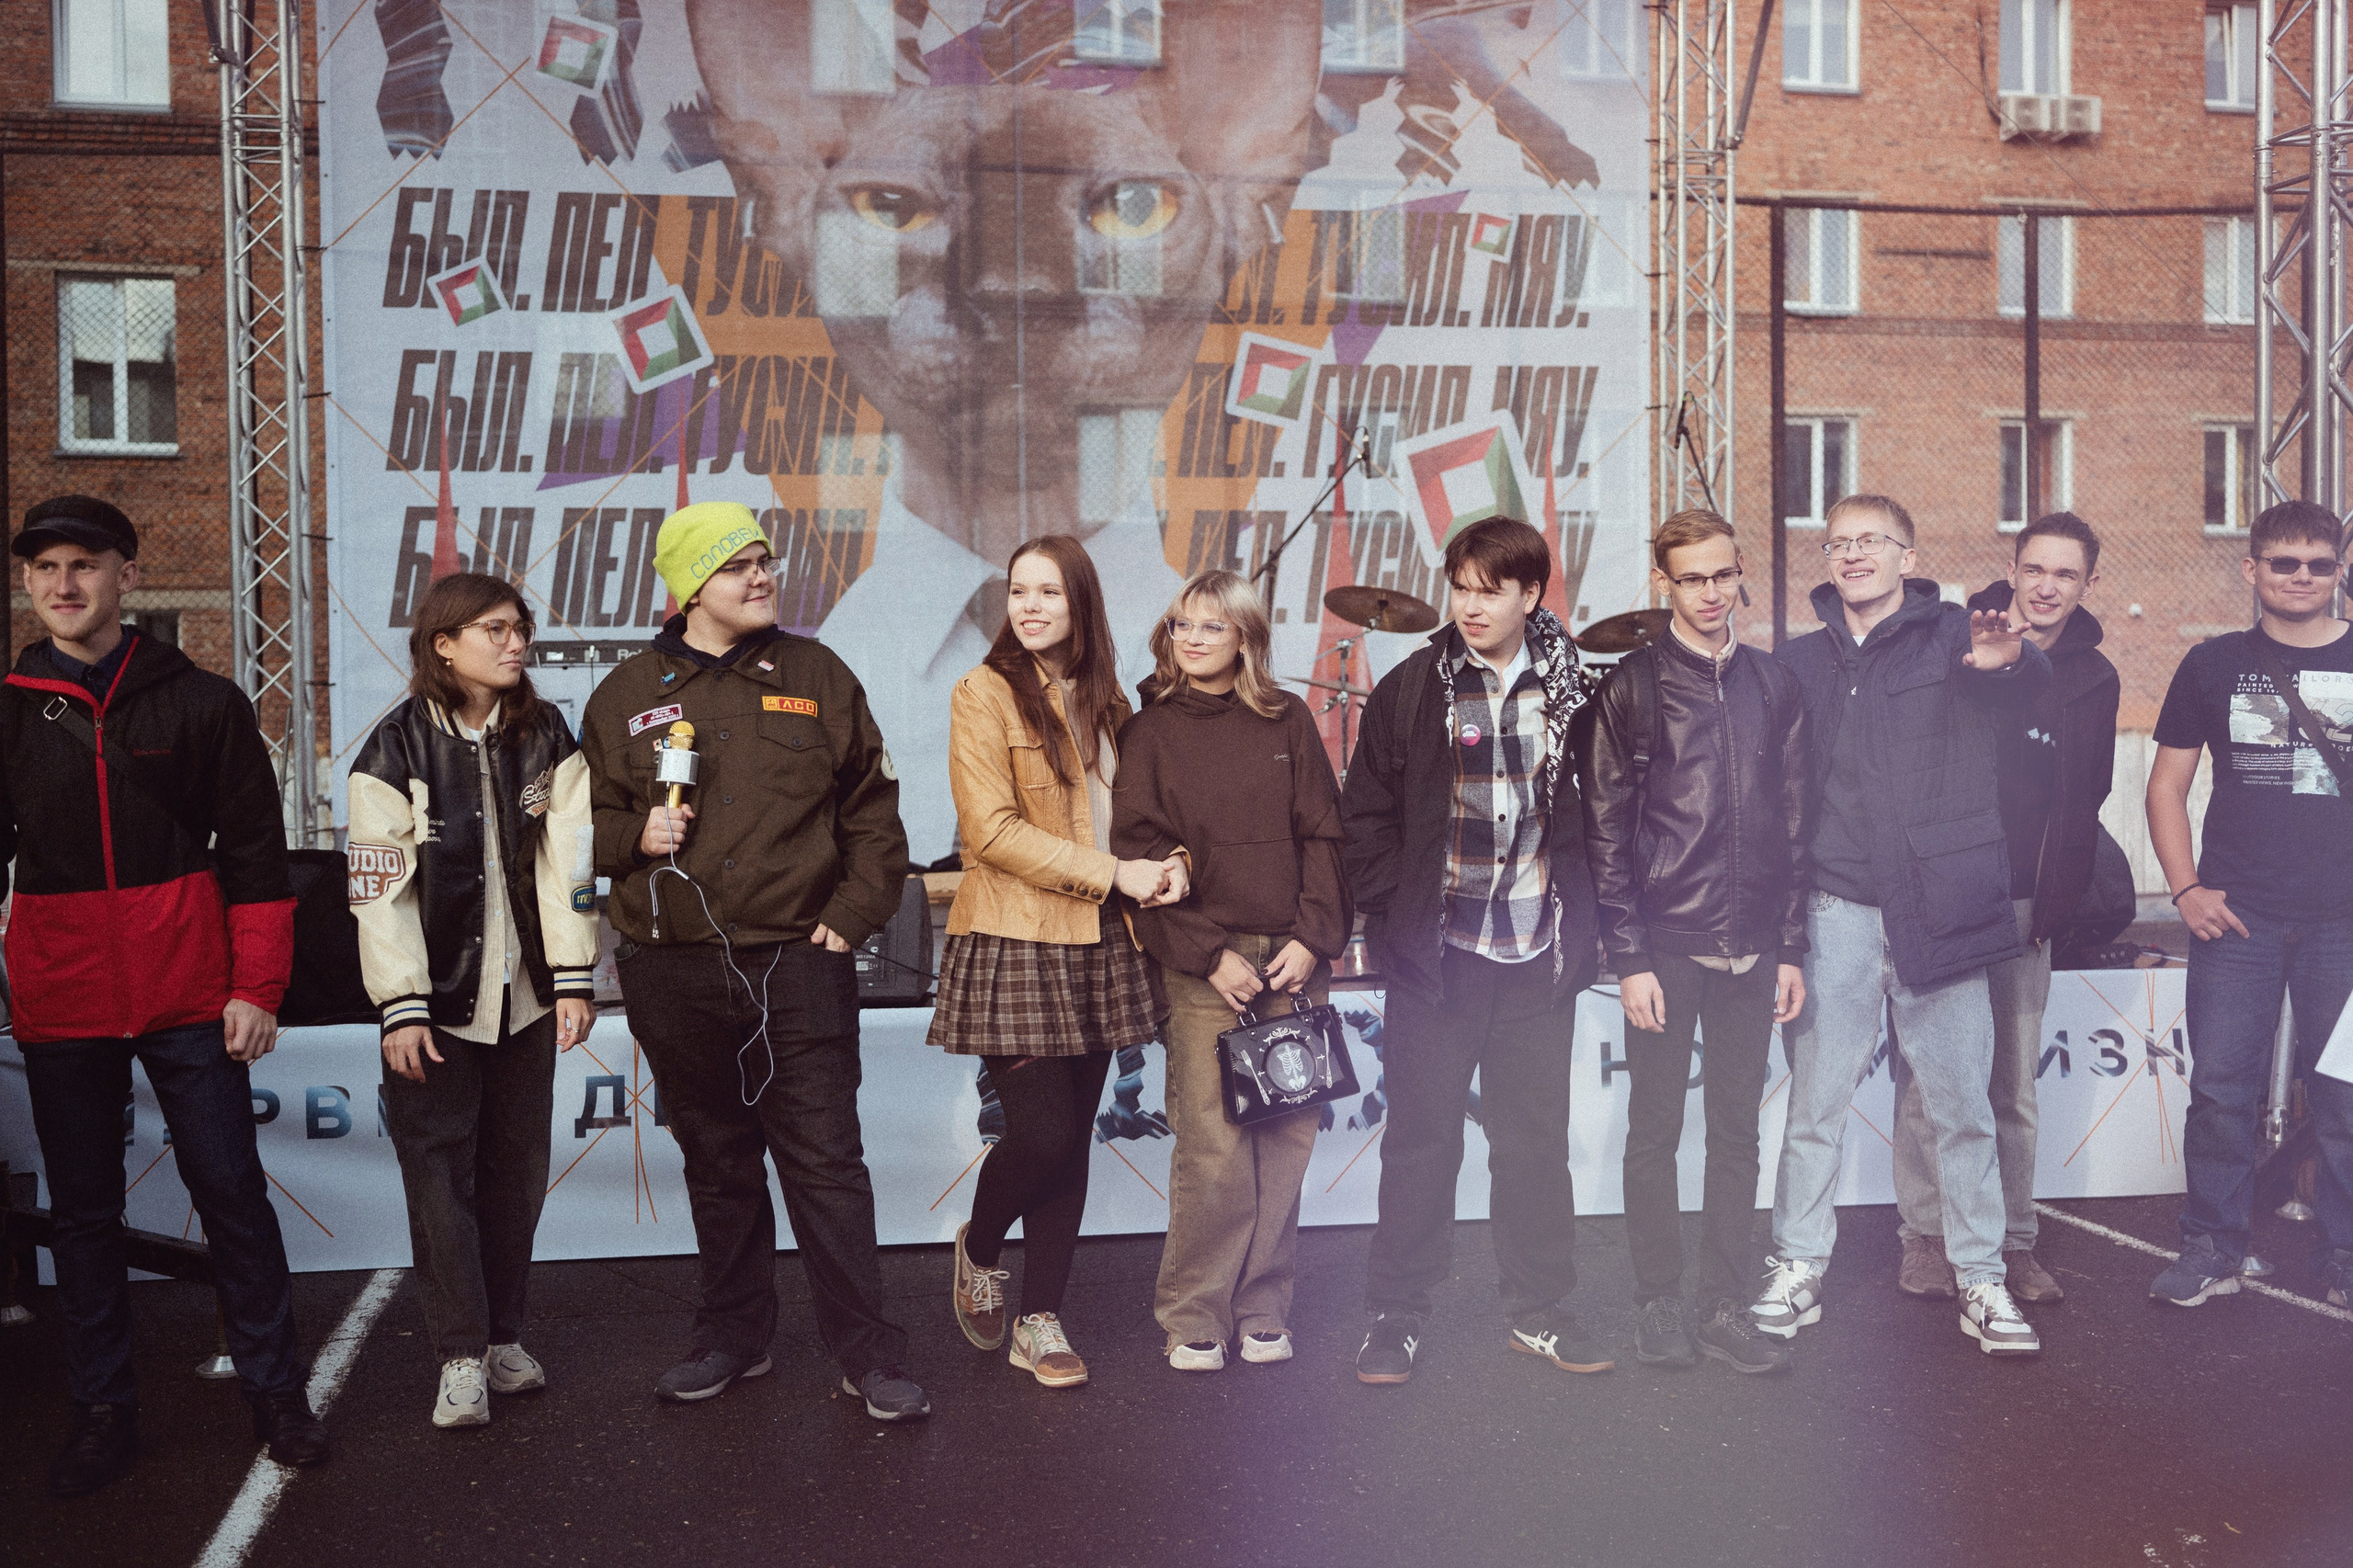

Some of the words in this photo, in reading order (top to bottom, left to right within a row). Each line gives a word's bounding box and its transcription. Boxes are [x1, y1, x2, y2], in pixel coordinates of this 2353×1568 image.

[386, 349, 533, 472] БЫЛ.
[2239, 674, 2271, 683] TOM
[2286, 674, 2342, 683] AILOR
